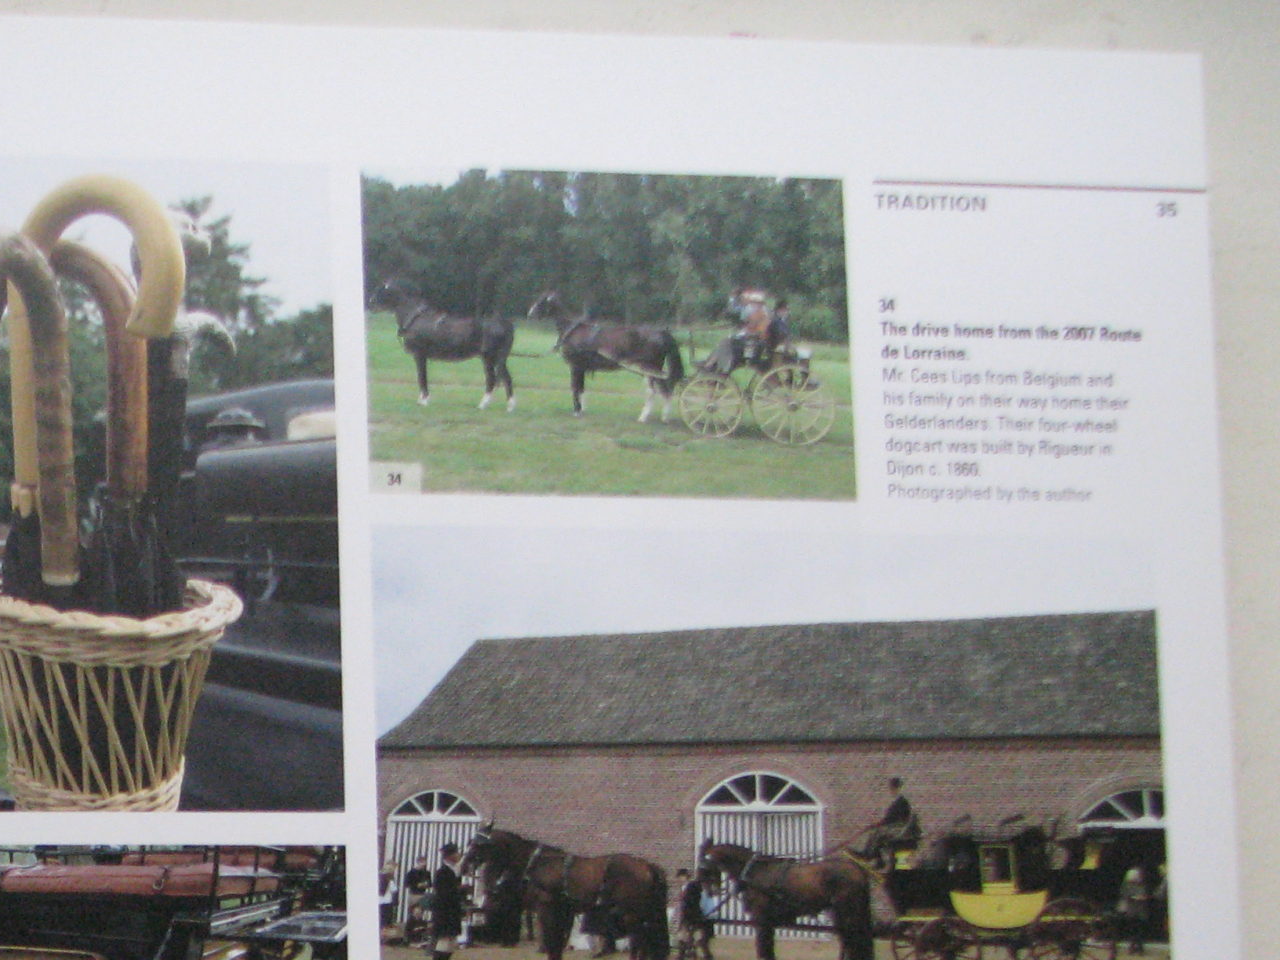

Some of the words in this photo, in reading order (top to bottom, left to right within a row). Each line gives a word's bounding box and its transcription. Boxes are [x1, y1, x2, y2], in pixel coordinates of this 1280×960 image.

[875, 194, 987, 211] TRADITION
[881, 323, 907, 337] The
[912, 323, 948, 338] drive
[954, 324, 993, 339] home
[998, 325, 1031, 339] from
[1036, 325, 1059, 340] the
[882, 346, 898, 359] de
[387, 473, 401, 486] 34
